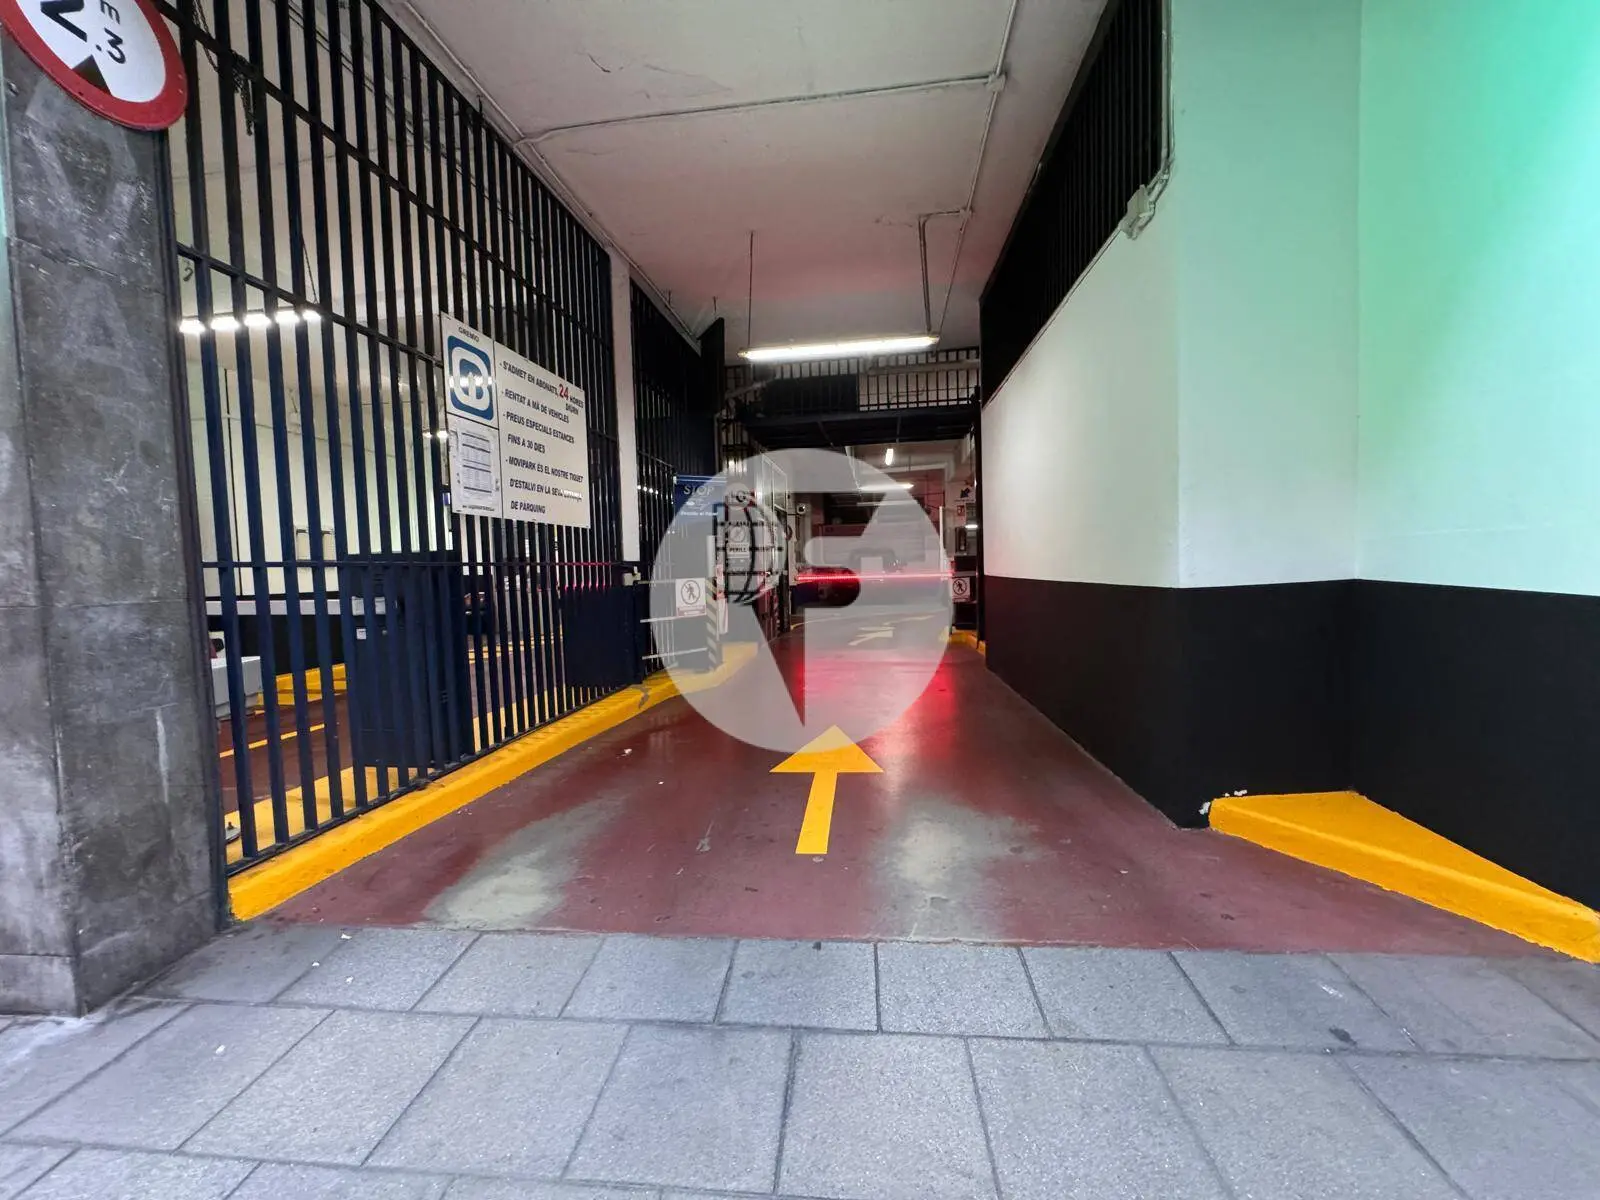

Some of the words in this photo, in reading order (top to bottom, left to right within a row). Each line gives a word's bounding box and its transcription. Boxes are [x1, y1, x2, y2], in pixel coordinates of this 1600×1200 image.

[458, 326, 480, 342] GREMIO
[502, 361, 527, 380] S'ADMET
[527, 373, 535, 385] EN
[559, 383, 569, 400] 24
[569, 395, 584, 409] HORES
[505, 388, 527, 405] RENTAT
[540, 404, 548, 415] DE
[548, 407, 570, 424] VEHICLES
[506, 411, 525, 426] PREUS
[525, 418, 552, 435] ESPECIALS
[553, 429, 575, 444] ESTANCES
[508, 433, 521, 446] FINS
[521, 438, 526, 447] A
[527, 440, 534, 449] 30
[534, 442, 546, 454] DIES
[509, 456, 537, 471] MOVIPARK
[544, 465, 551, 475] EL
[551, 467, 569, 480] NOSTRE
[569, 472, 584, 483] TIQUET
[509, 478, 537, 492] D'ESTALVI
[536, 484, 544, 493] EN
[544, 486, 551, 494] LA
[683, 484, 715, 496] STOP
[511, 500, 518, 510] DE
[519, 502, 546, 514] PARQUING
